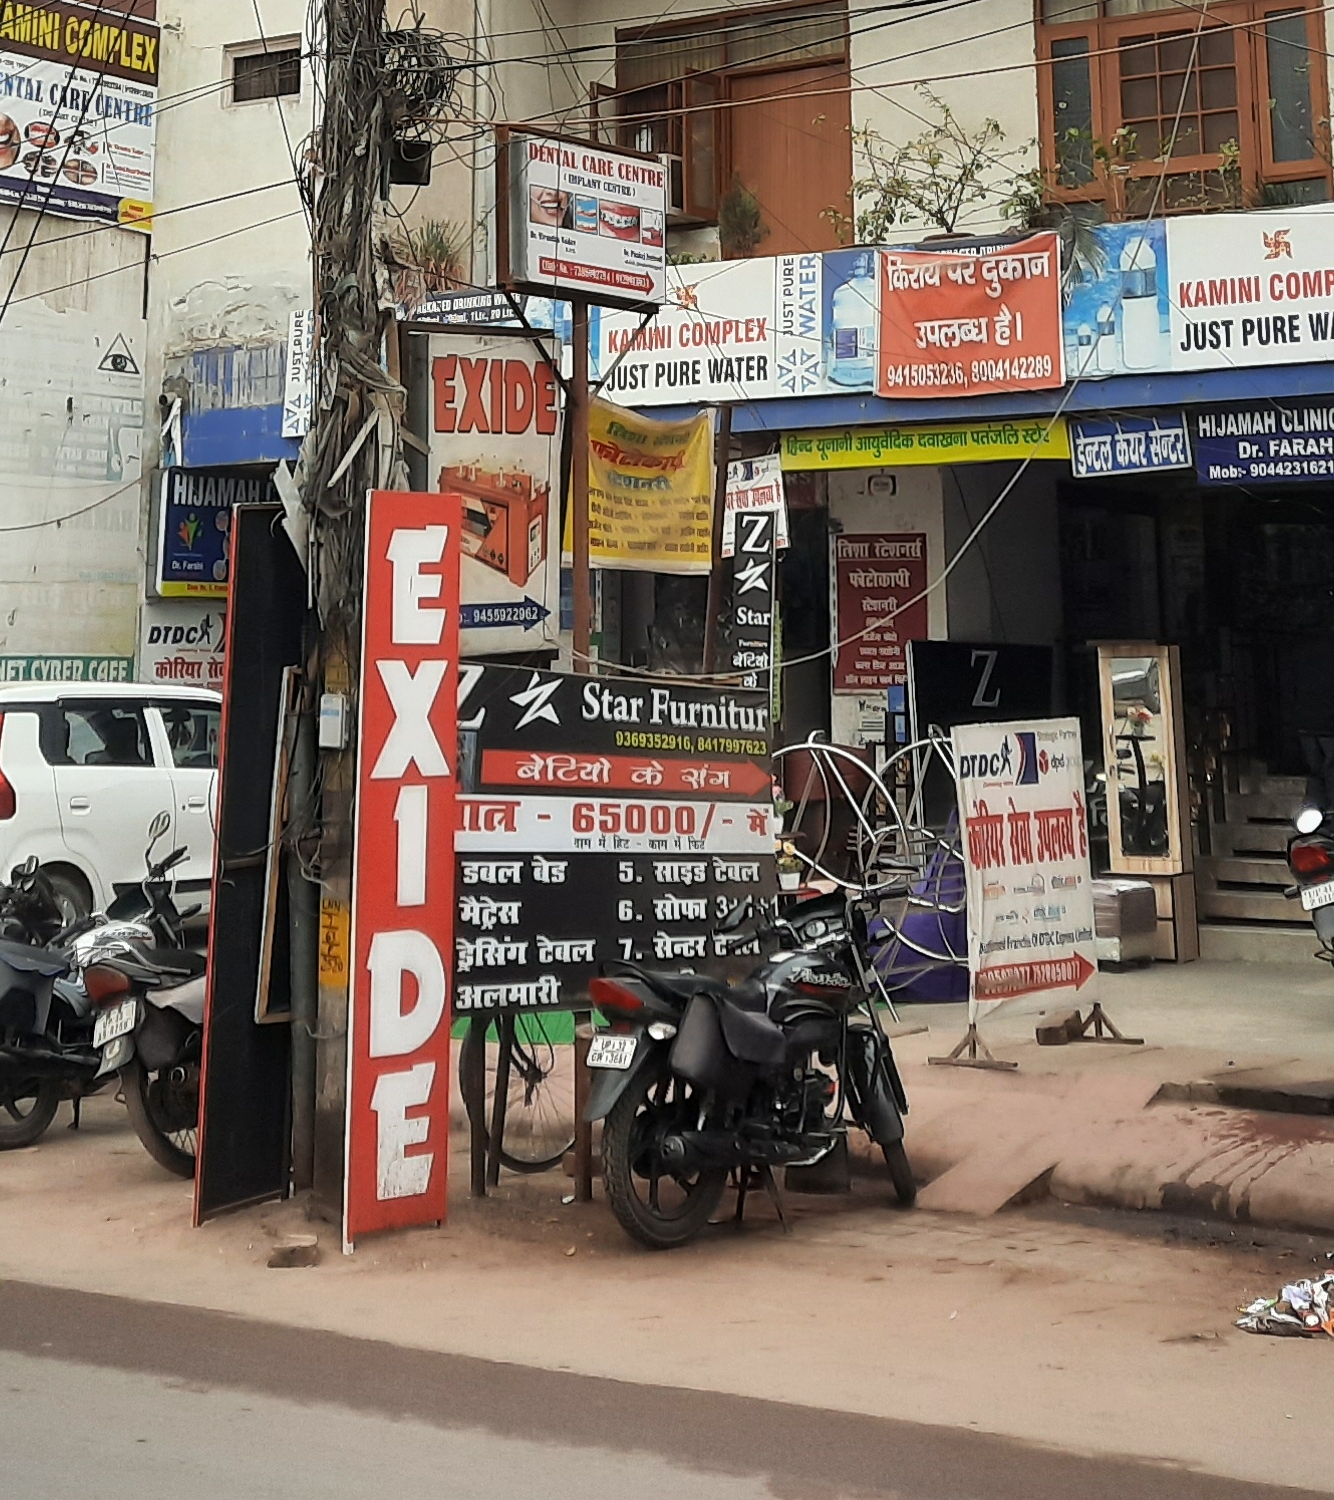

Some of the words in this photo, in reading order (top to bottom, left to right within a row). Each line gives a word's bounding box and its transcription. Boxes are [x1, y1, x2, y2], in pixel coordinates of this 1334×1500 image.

[66, 16, 156, 74] COMPLEX
[50, 83, 89, 112] CARE
[95, 93, 152, 128] CENTRE
[529, 142, 578, 169] DENTAL
[582, 155, 614, 177] CARE
[618, 163, 663, 188] CENTRE
[783, 257, 794, 297] PURE
[947, 258, 976, 285] पर
[981, 252, 1052, 298] दुकान
[1179, 275, 1261, 308] KAMINI
[799, 254, 816, 337] WATER
[293, 310, 304, 347] PURE
[608, 324, 672, 354] KAMINI
[679, 317, 768, 348] COMPLEX
[782, 301, 794, 337] JUST
[914, 317, 987, 349] उपलब्ध
[1180, 319, 1234, 352] JUST
[1241, 313, 1301, 347] PURE
[291, 350, 304, 382] JUST
[607, 363, 649, 392] JUST
[655, 360, 701, 388] PURE
[708, 355, 768, 383] WATER
[972, 355, 1052, 382] 8004142289
[432, 354, 557, 435] EXIDE
[1198, 409, 1276, 438] HIJAMAH
[816, 431, 853, 460] यूनानी
[1116, 420, 1148, 467] केयर
[1150, 416, 1187, 467] सेन्टर
[1239, 441, 1264, 460] Dr.
[1249, 460, 1334, 477] 9044231621
[174, 474, 262, 507] HIJAMAH
[736, 607, 771, 626] Star
[148, 624, 198, 646] DTDC
[154, 656, 202, 681] कोरियर
[581, 682, 644, 725] Star
[630, 760, 663, 788] के
[679, 766, 732, 791] संग
[960, 753, 1000, 780] DTDC
[571, 802, 734, 840] 65000/-
[746, 806, 770, 836] में
[366, 525, 452, 1200] EXIDE
[618, 860, 643, 883] 5.
[652, 860, 708, 887] साइड
[618, 898, 643, 922] 6.
[652, 893, 708, 922] सोफा
[618, 936, 643, 960] 7.
[652, 930, 708, 960] सेन्टर
[455, 974, 563, 1011] अलमारी
